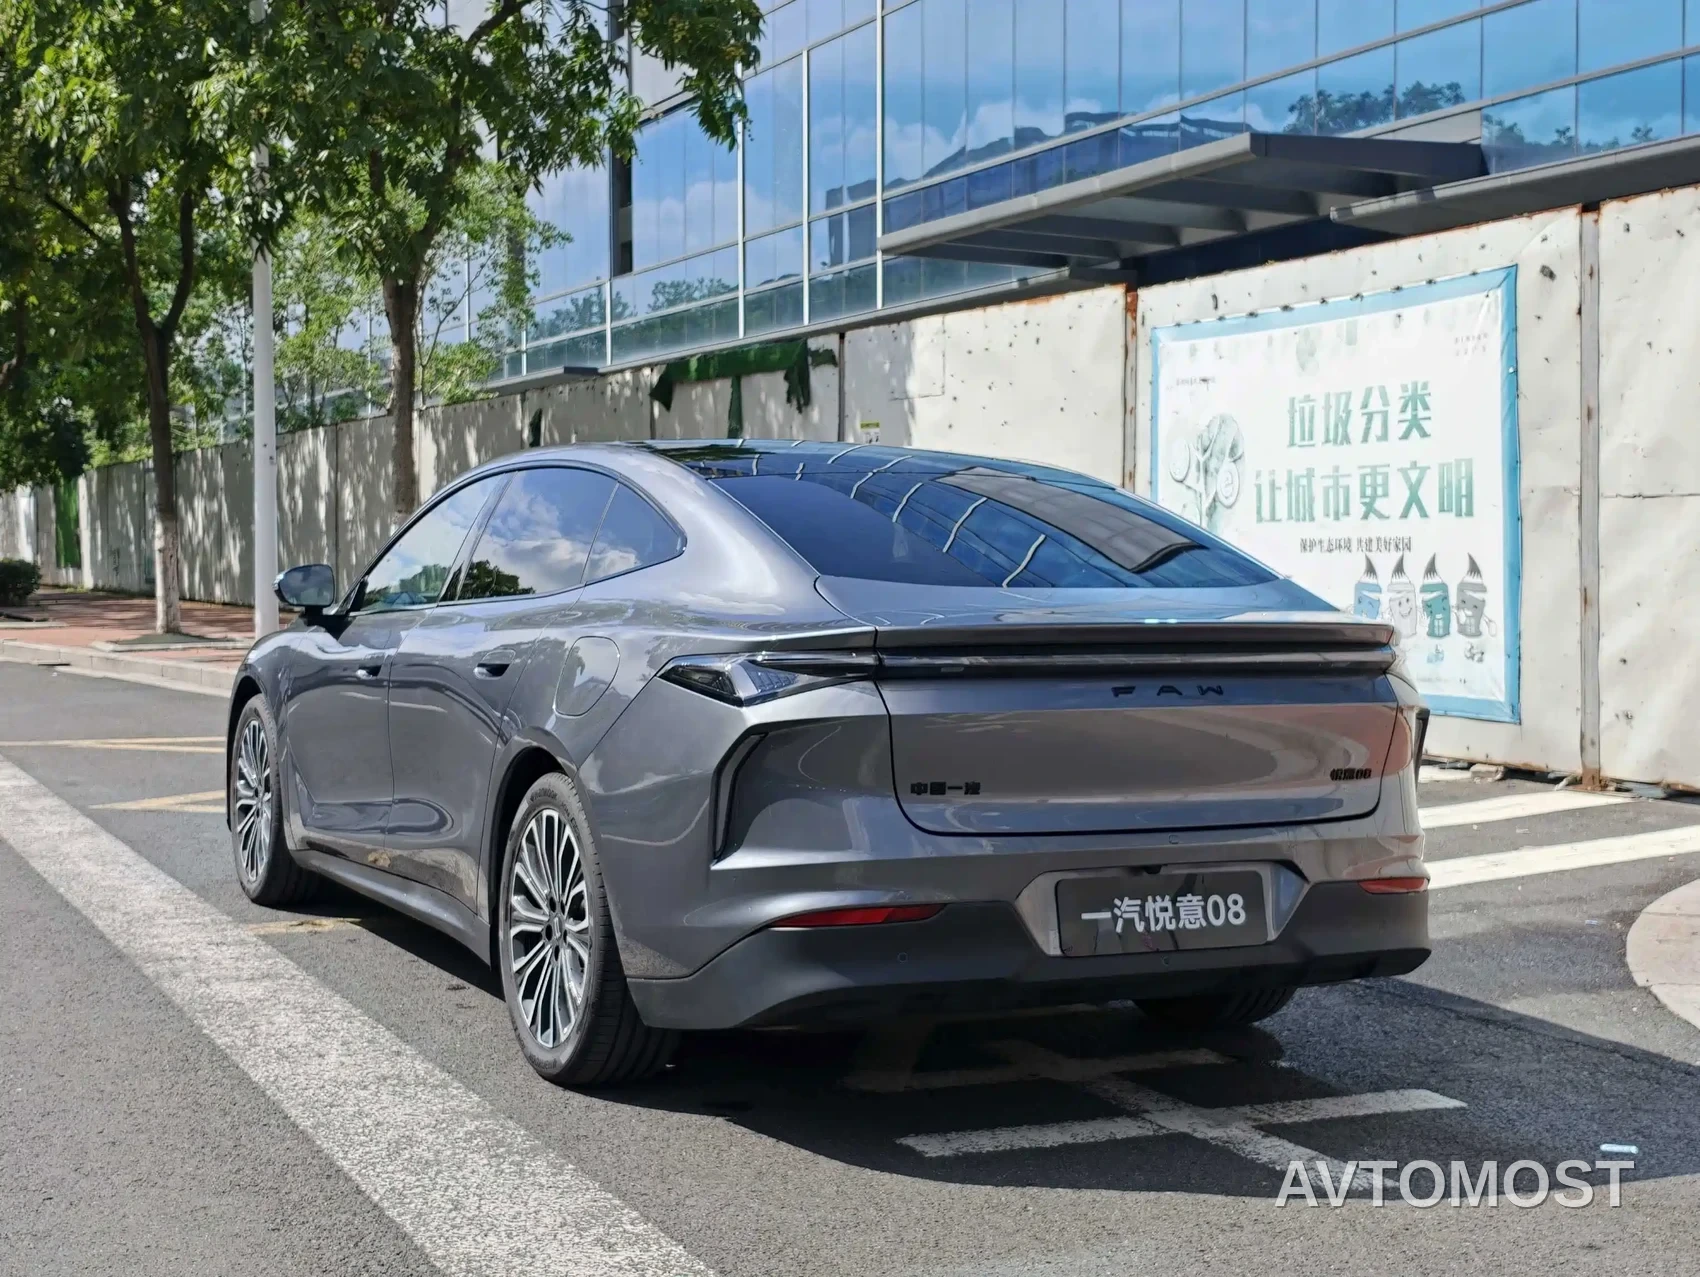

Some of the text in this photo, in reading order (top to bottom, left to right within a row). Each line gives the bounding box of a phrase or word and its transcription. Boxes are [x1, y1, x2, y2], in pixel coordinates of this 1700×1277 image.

[1287, 380, 1432, 448] 垃圾分类
[1254, 457, 1475, 524] 让城市更文明
[1081, 893, 1247, 934] 一汽悦意08
